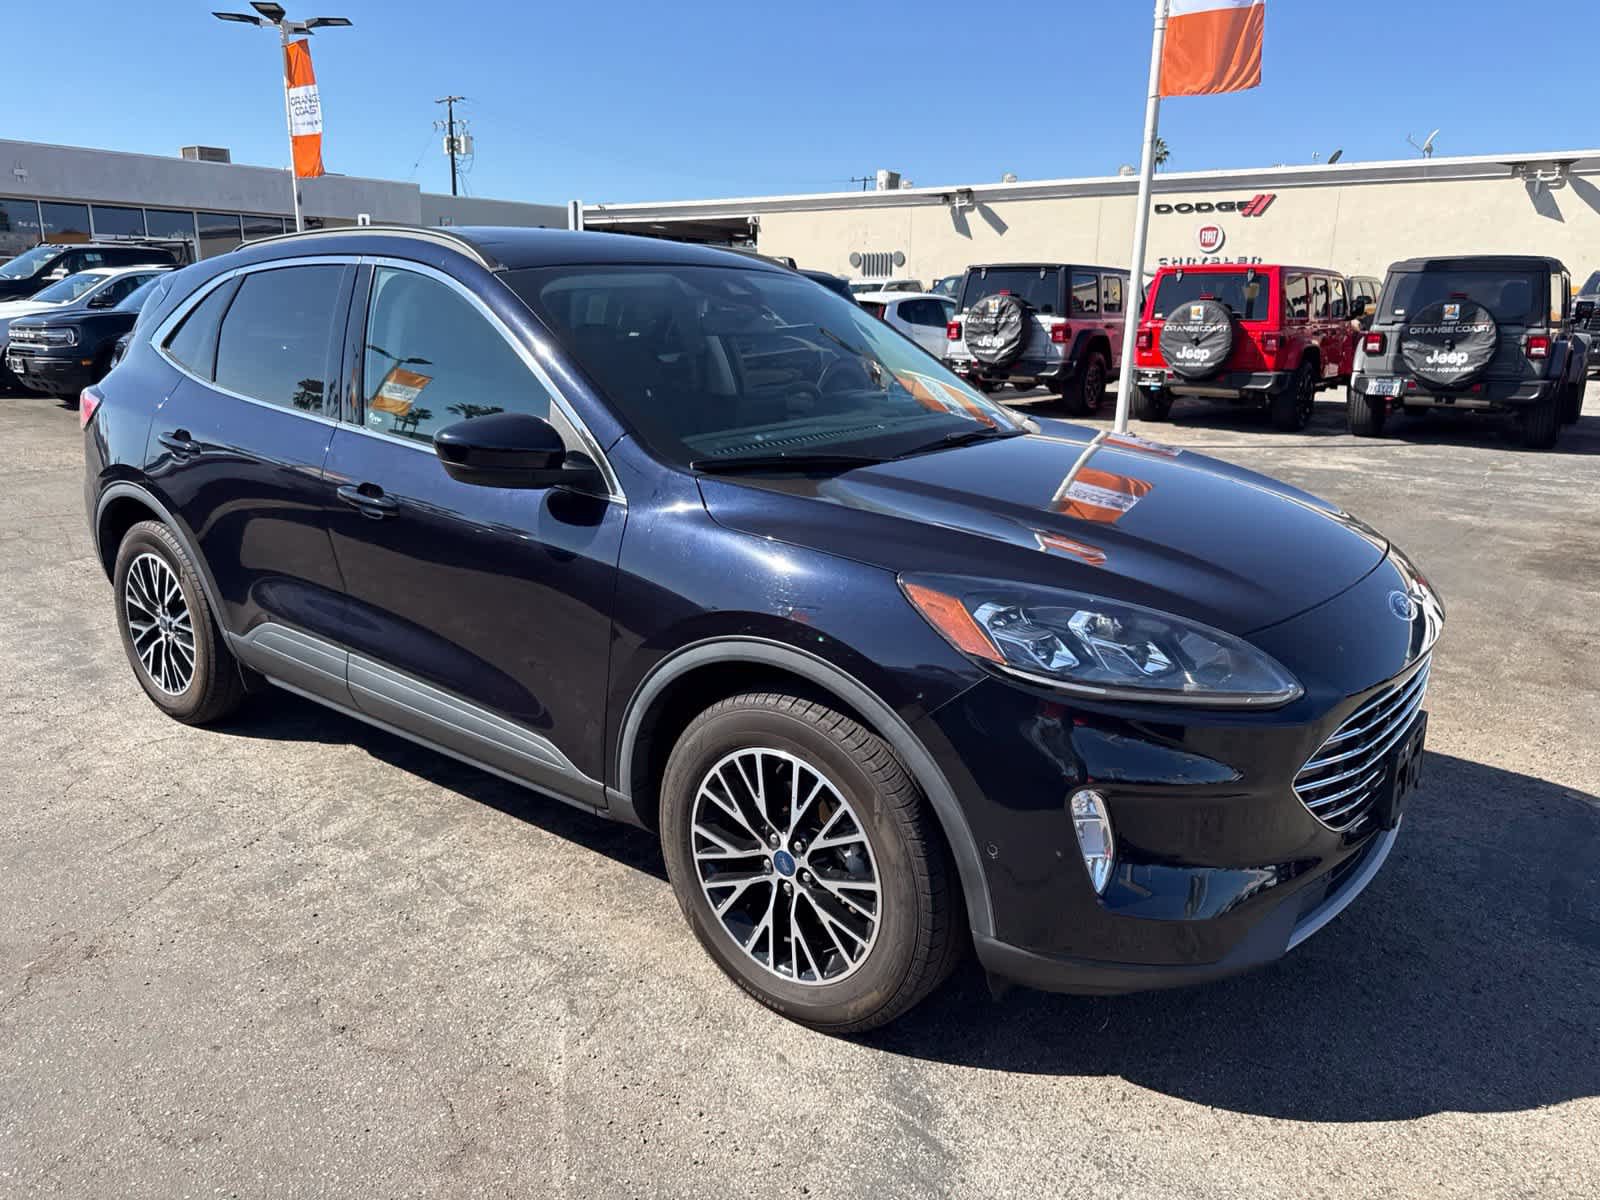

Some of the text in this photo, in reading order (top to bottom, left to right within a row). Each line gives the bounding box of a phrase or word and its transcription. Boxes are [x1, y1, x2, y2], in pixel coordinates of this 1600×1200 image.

[1154, 201, 1252, 214] DODGE
[1202, 230, 1217, 244] FIAT
[1164, 324, 1227, 332] ORANGE COAST
[1409, 324, 1489, 335] ORANGE COAST
[978, 335, 1004, 348] Jeep
[1176, 346, 1210, 362] Jeep
[1426, 350, 1468, 366] Jeep
